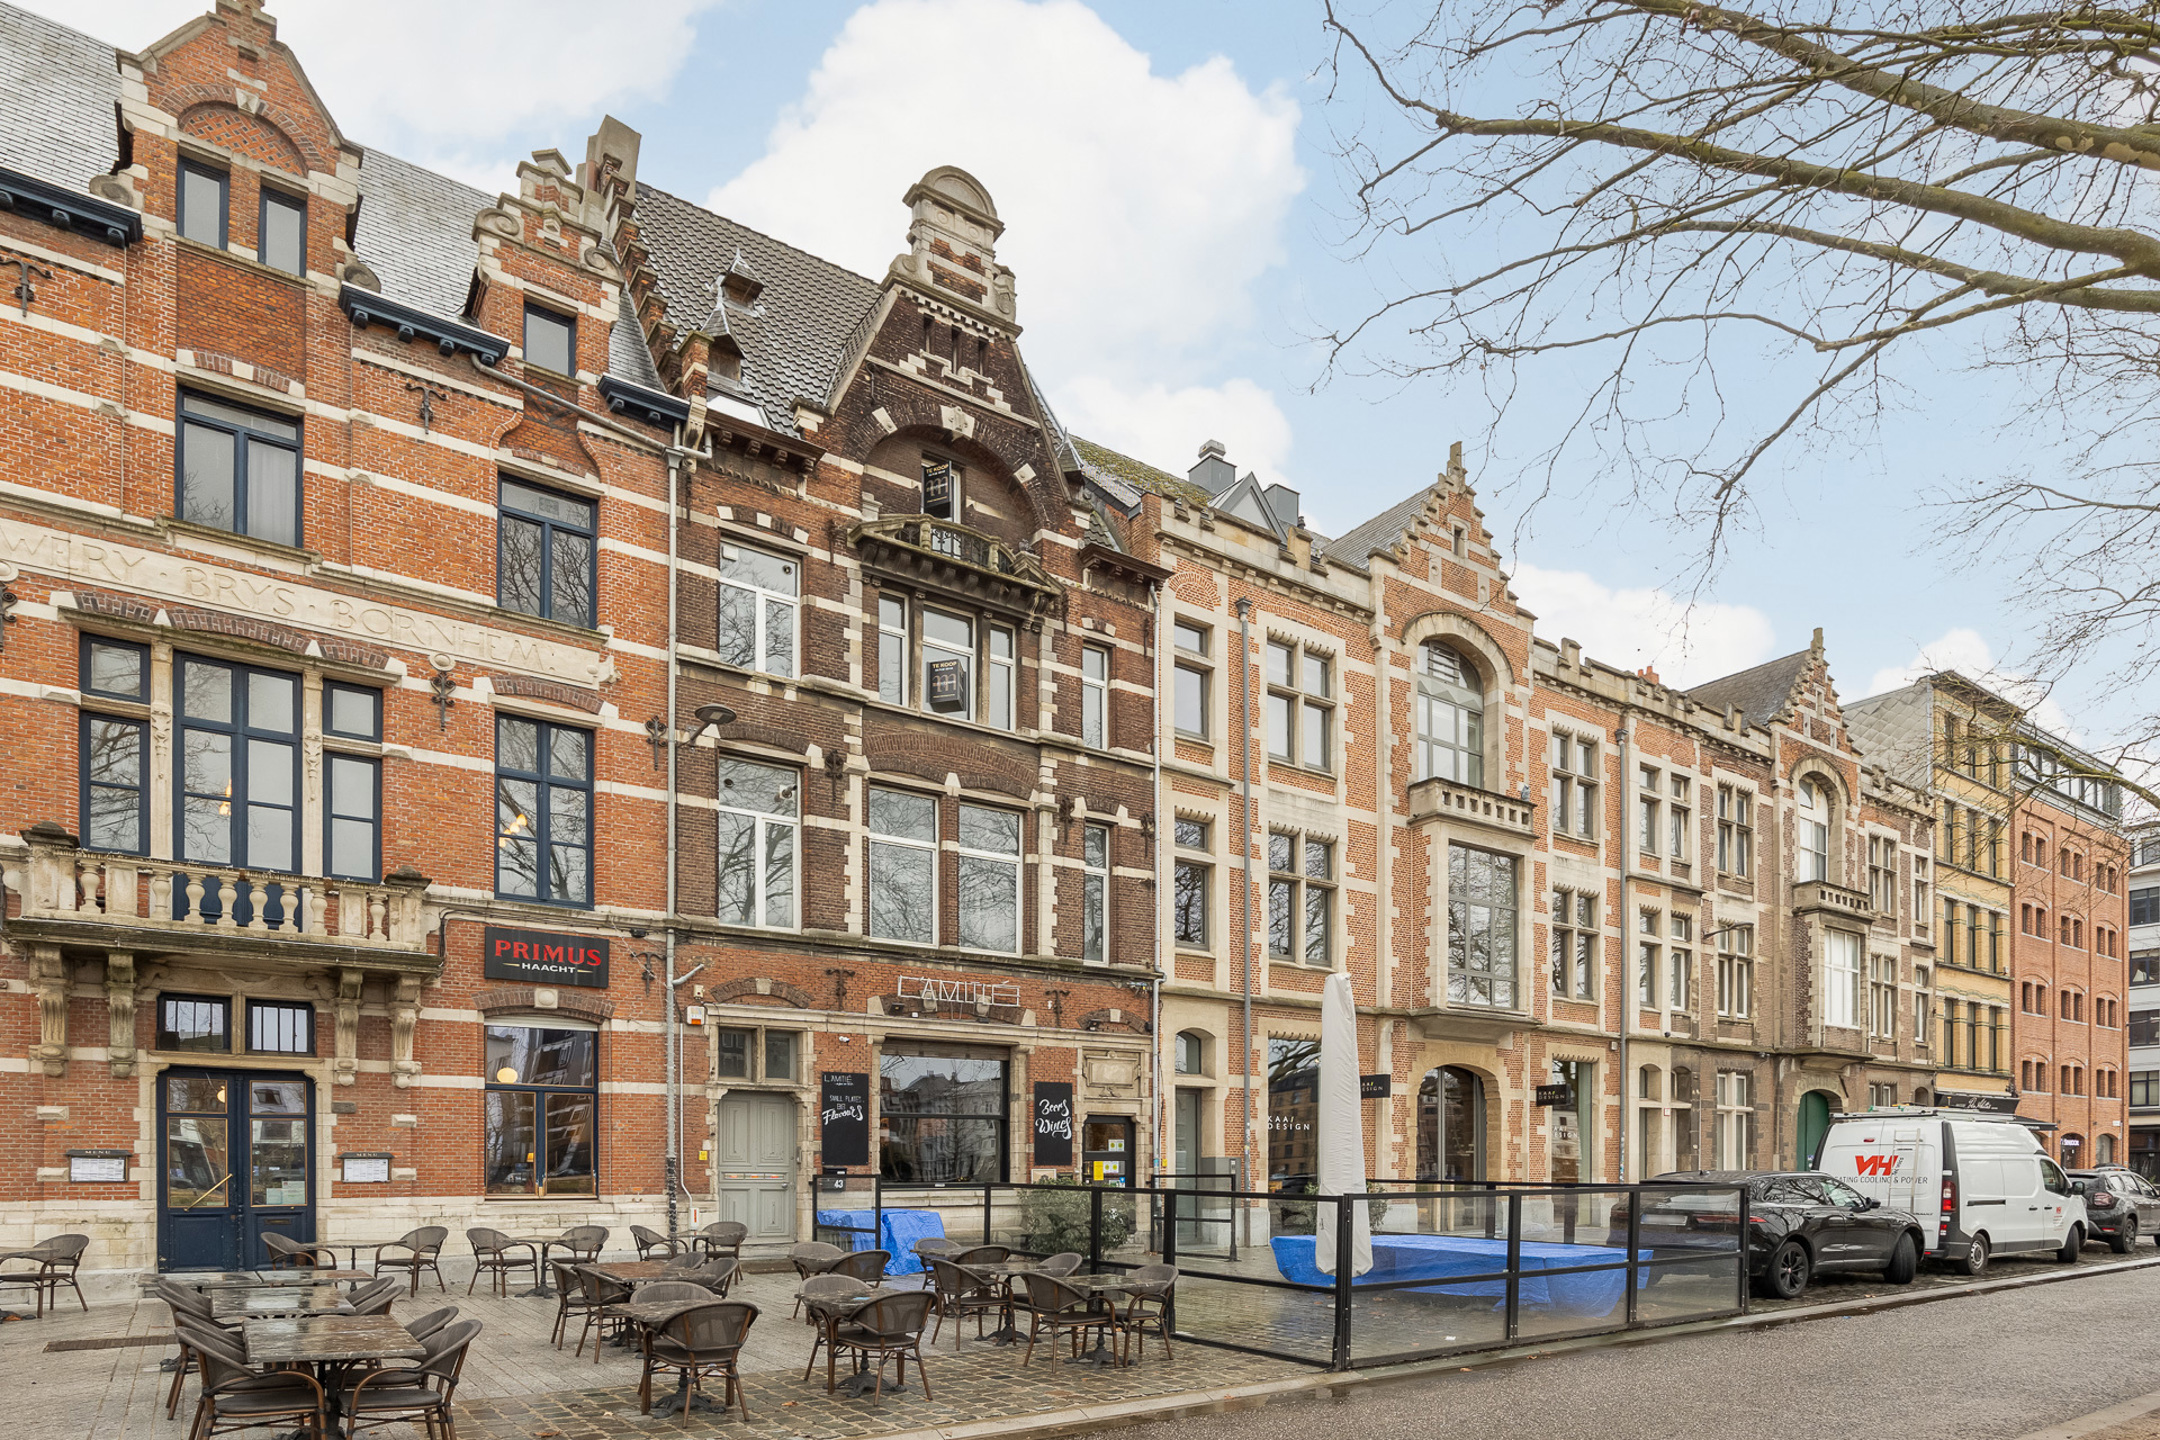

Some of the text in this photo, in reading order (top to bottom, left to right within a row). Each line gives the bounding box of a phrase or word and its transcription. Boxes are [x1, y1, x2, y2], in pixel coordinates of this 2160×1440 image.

[181, 566, 295, 616] BRYS
[495, 940, 602, 966] PRIMUS
[522, 962, 576, 973] HAACHT
[1039, 1099, 1070, 1117] Beers
[1035, 1117, 1072, 1140] Wines
[834, 1180, 843, 1189] 43
